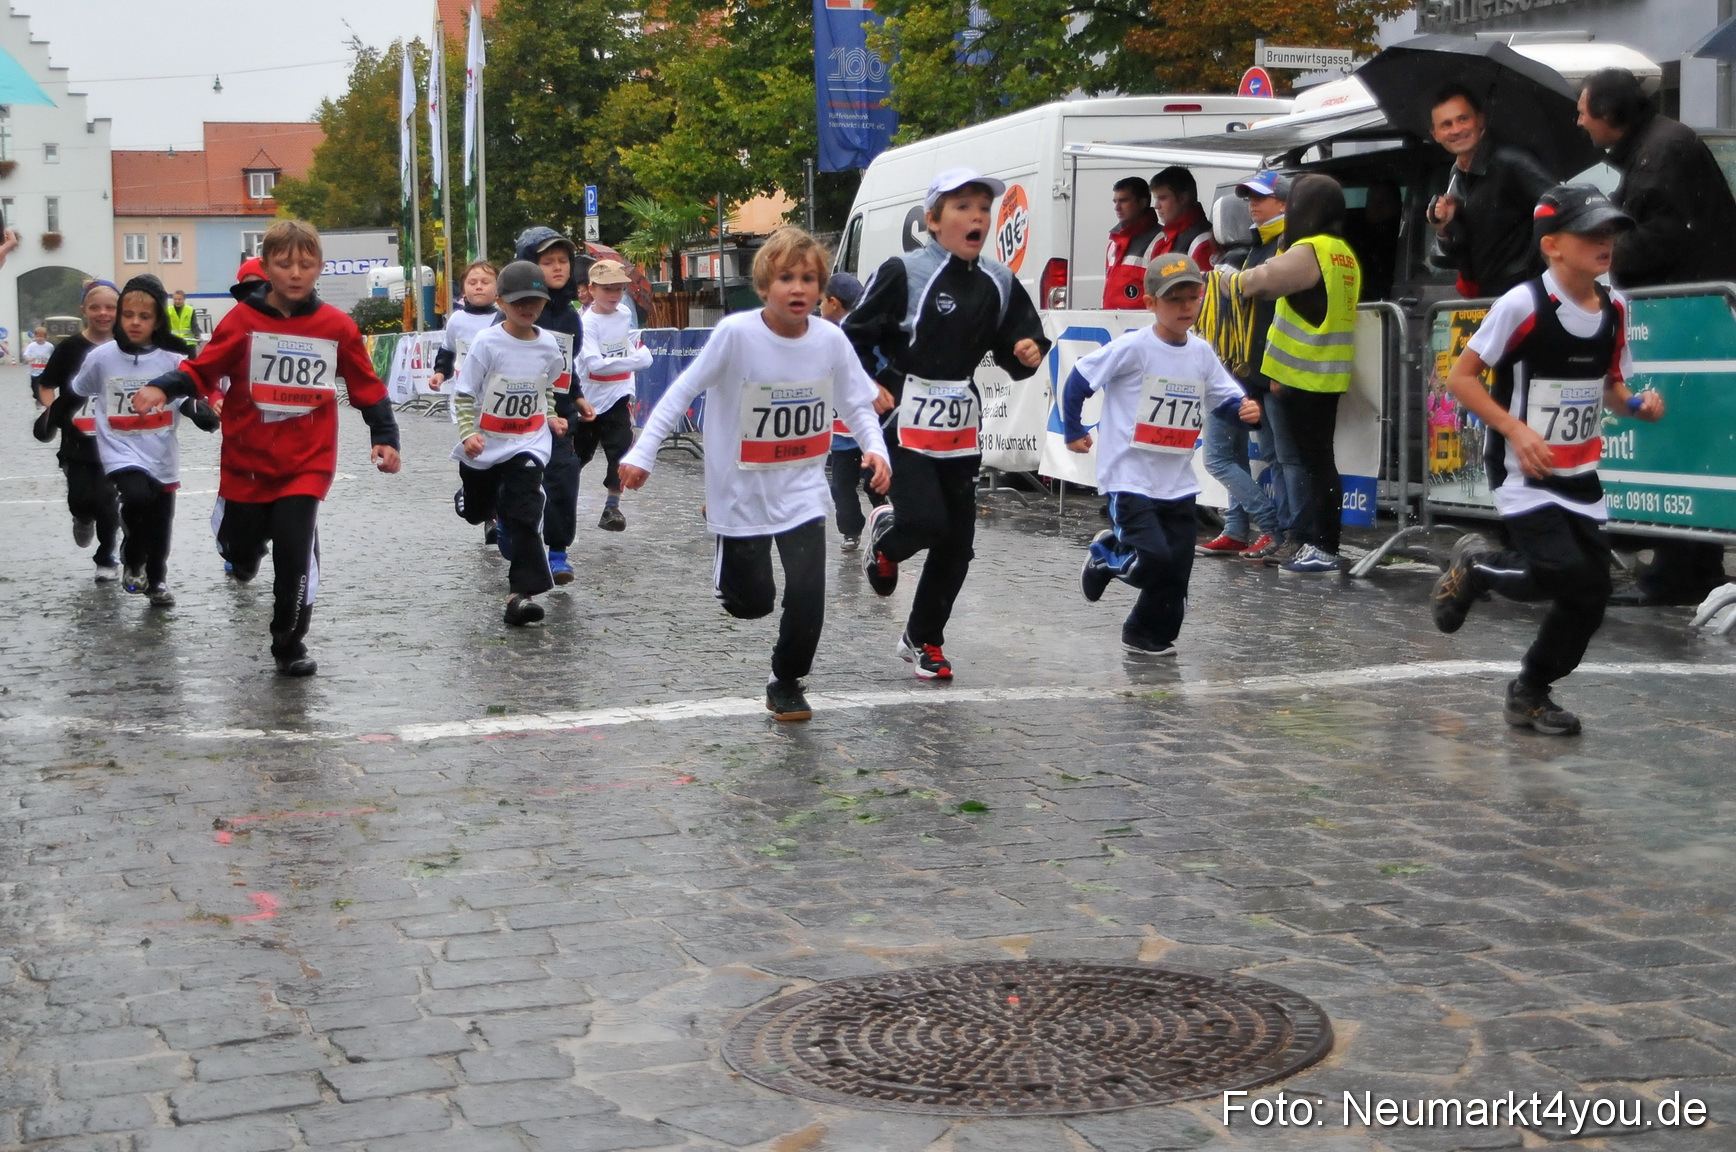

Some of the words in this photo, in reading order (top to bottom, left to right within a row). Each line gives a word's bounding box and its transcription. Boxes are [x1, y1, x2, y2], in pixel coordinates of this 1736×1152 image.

[827, 47, 886, 84] 100
[1266, 50, 1350, 68] Brunnwirtsgasse
[587, 189, 595, 212] P
[320, 258, 388, 276] BOCK
[261, 354, 328, 386] 7082
[272, 389, 313, 404] Lorenz
[752, 401, 825, 438] 7000
[911, 396, 973, 428] 7297
[1148, 395, 1202, 428] 7173
[995, 433, 1037, 451] Neumarkt
[1150, 427, 1188, 446] SAM
[1626, 489, 1661, 513] 09181
[1663, 492, 1693, 516] 6352
